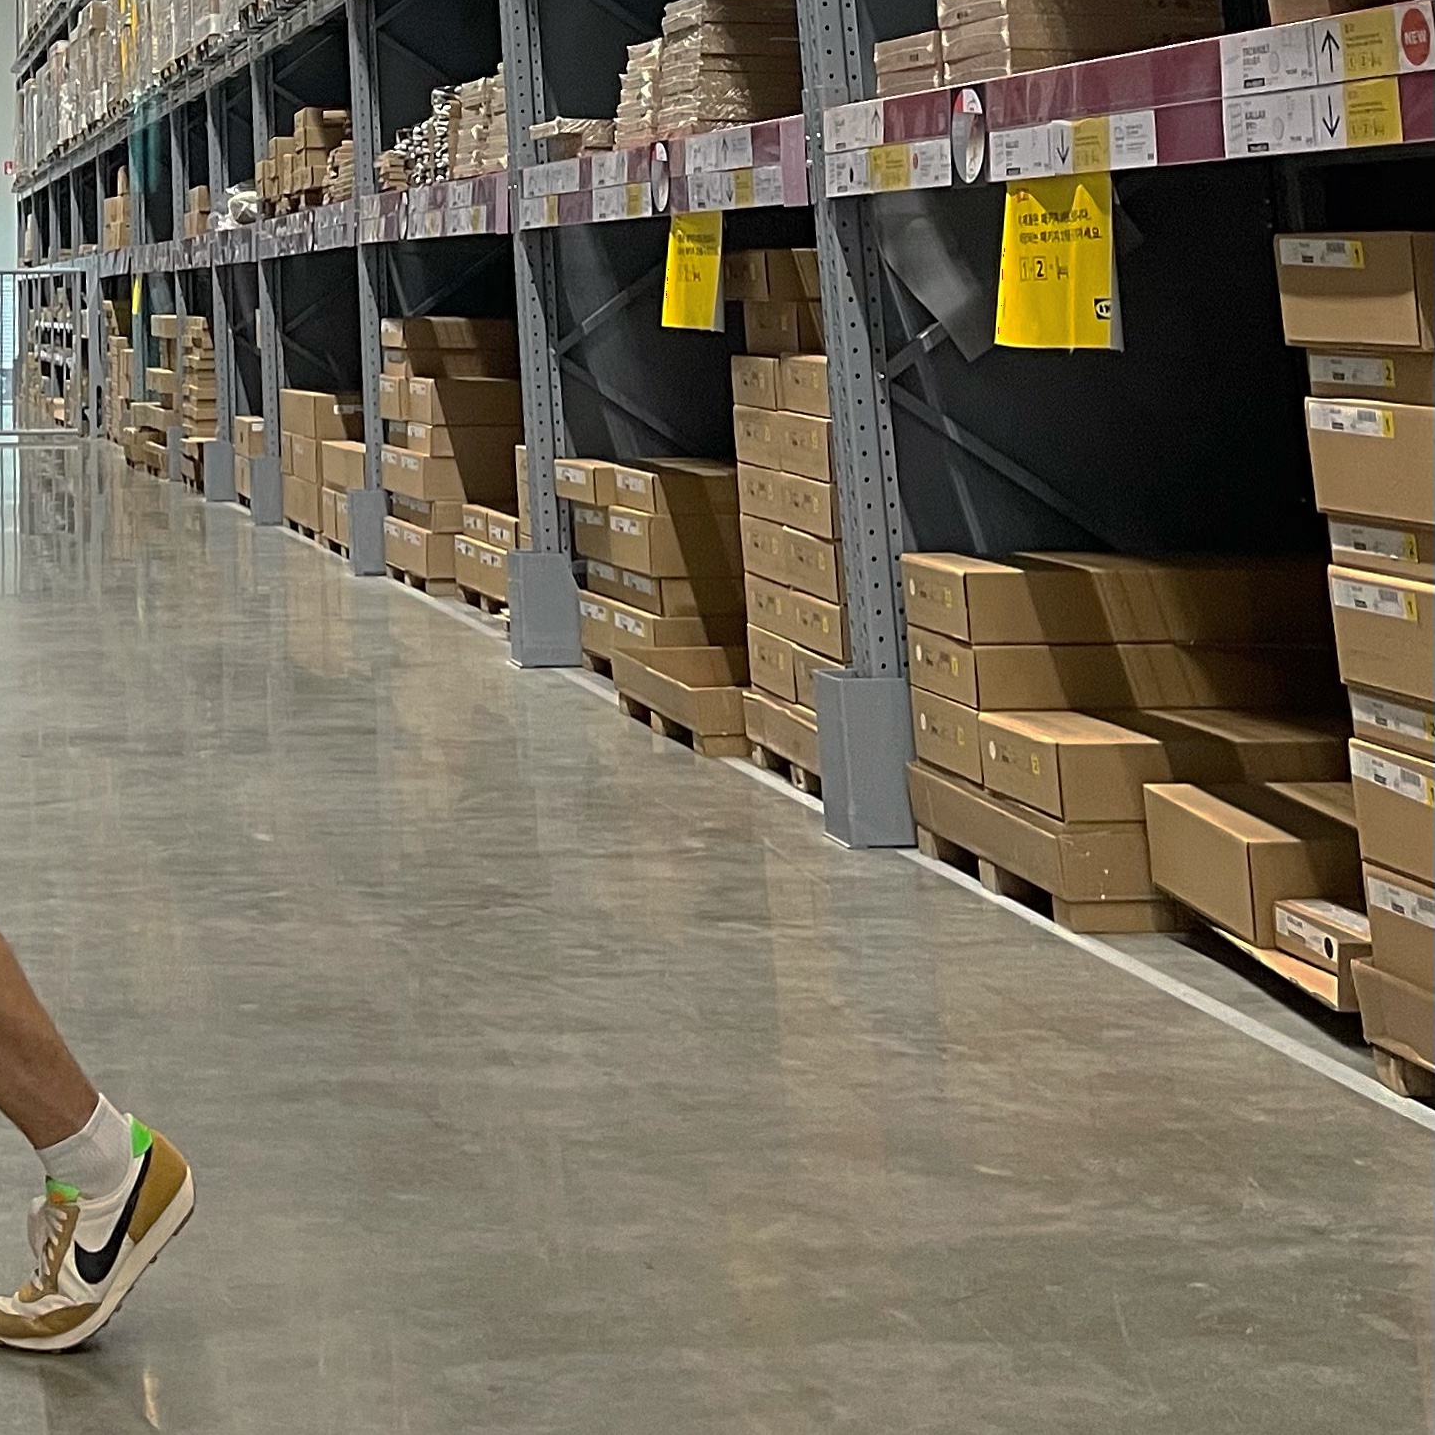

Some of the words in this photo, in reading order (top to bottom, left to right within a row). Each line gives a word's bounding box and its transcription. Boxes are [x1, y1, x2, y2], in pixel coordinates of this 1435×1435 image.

[1404, 29, 1427, 45] NEW
[1036, 259, 1044, 278] 2
[1385, 365, 1393, 381] 2
